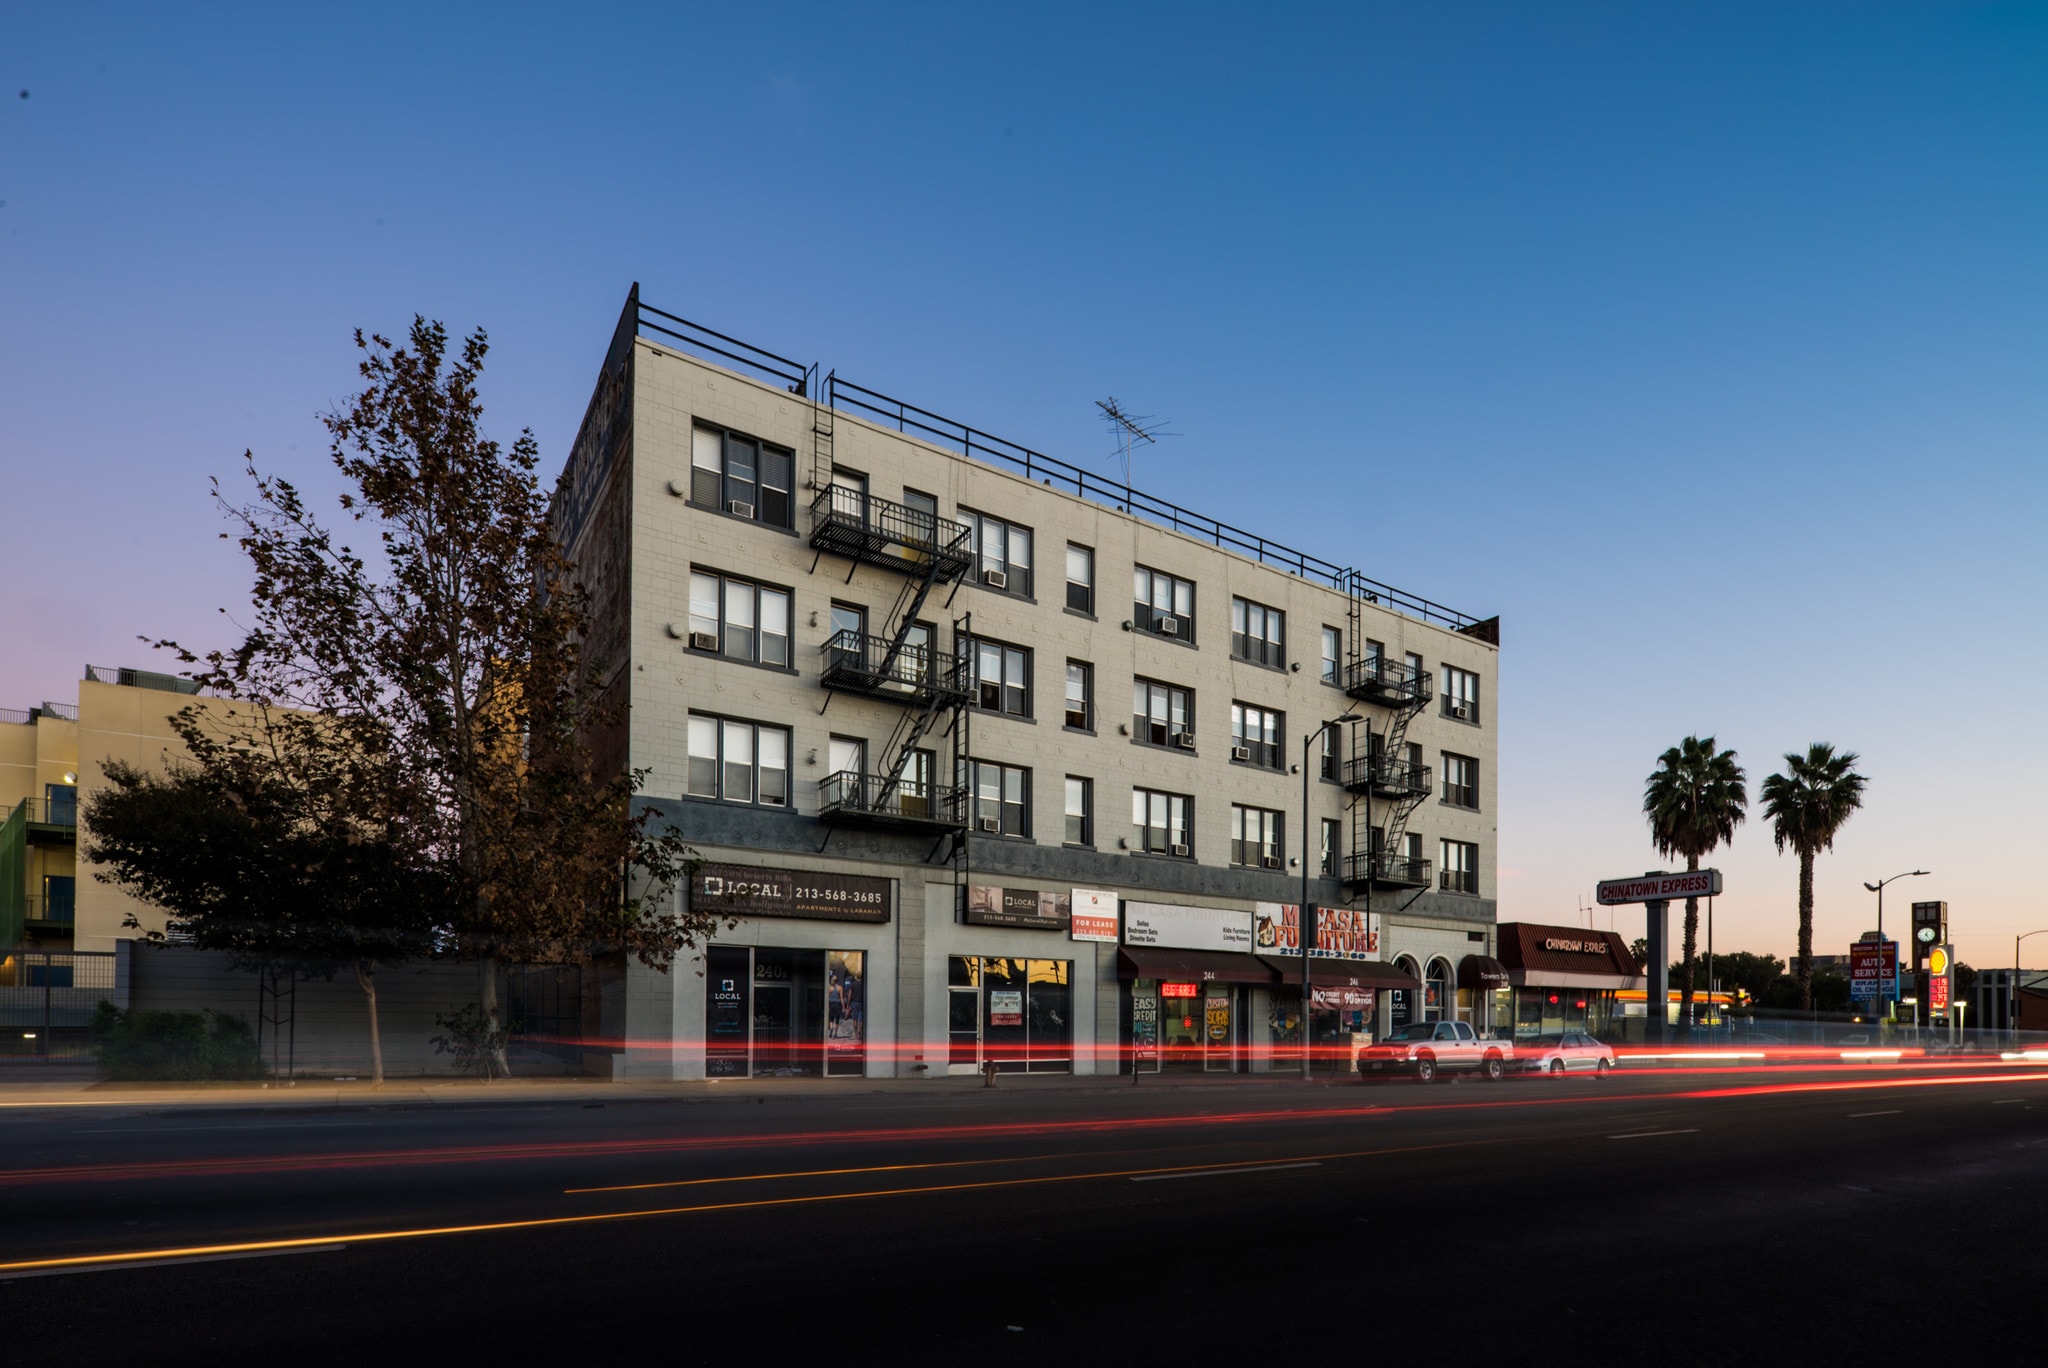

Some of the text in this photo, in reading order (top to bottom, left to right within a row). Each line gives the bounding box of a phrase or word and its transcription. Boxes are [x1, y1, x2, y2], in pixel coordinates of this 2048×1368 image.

[727, 881, 781, 897] LOCAL
[1601, 875, 1708, 899] CHINATOWN EXPRESS
[795, 887, 882, 904] 213-568-3685
[796, 904, 841, 912] APARTMENTS
[1014, 898, 1036, 906] LOCAL
[1075, 919, 1114, 928] FOR LEASE
[1274, 925, 1379, 952] FUNITURE
[1203, 971, 1215, 980] 244
[1854, 968, 1893, 977] SERVCE
[1312, 989, 1326, 1002] NO
[1344, 992, 1354, 1004] 90
[1134, 997, 1157, 1010] EASY
